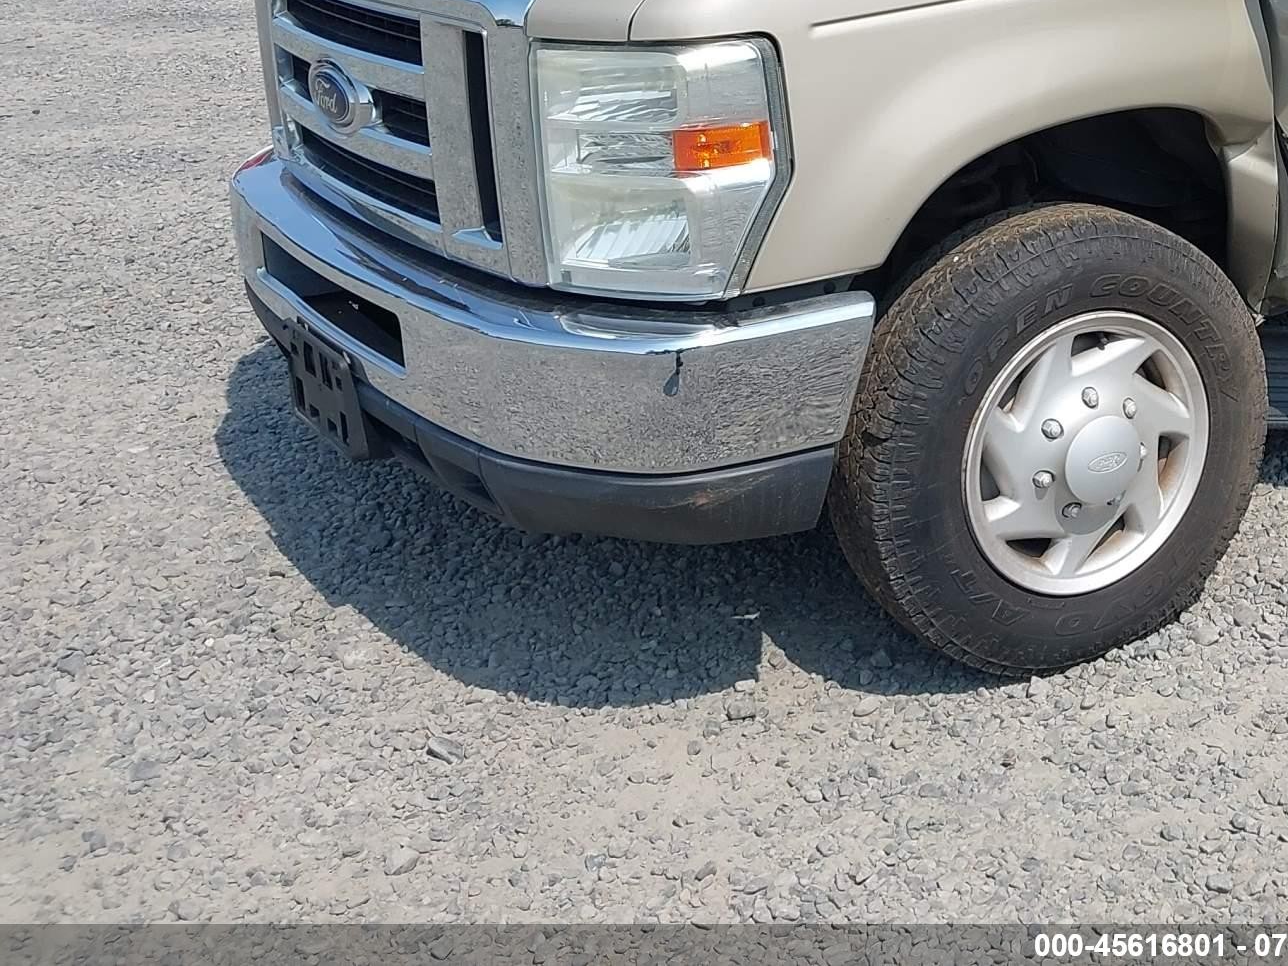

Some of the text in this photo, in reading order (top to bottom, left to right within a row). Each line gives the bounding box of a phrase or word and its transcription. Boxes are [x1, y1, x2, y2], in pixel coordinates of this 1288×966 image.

[315, 77, 338, 114] Ford
[964, 273, 1240, 403] OPEN COUNTRY
